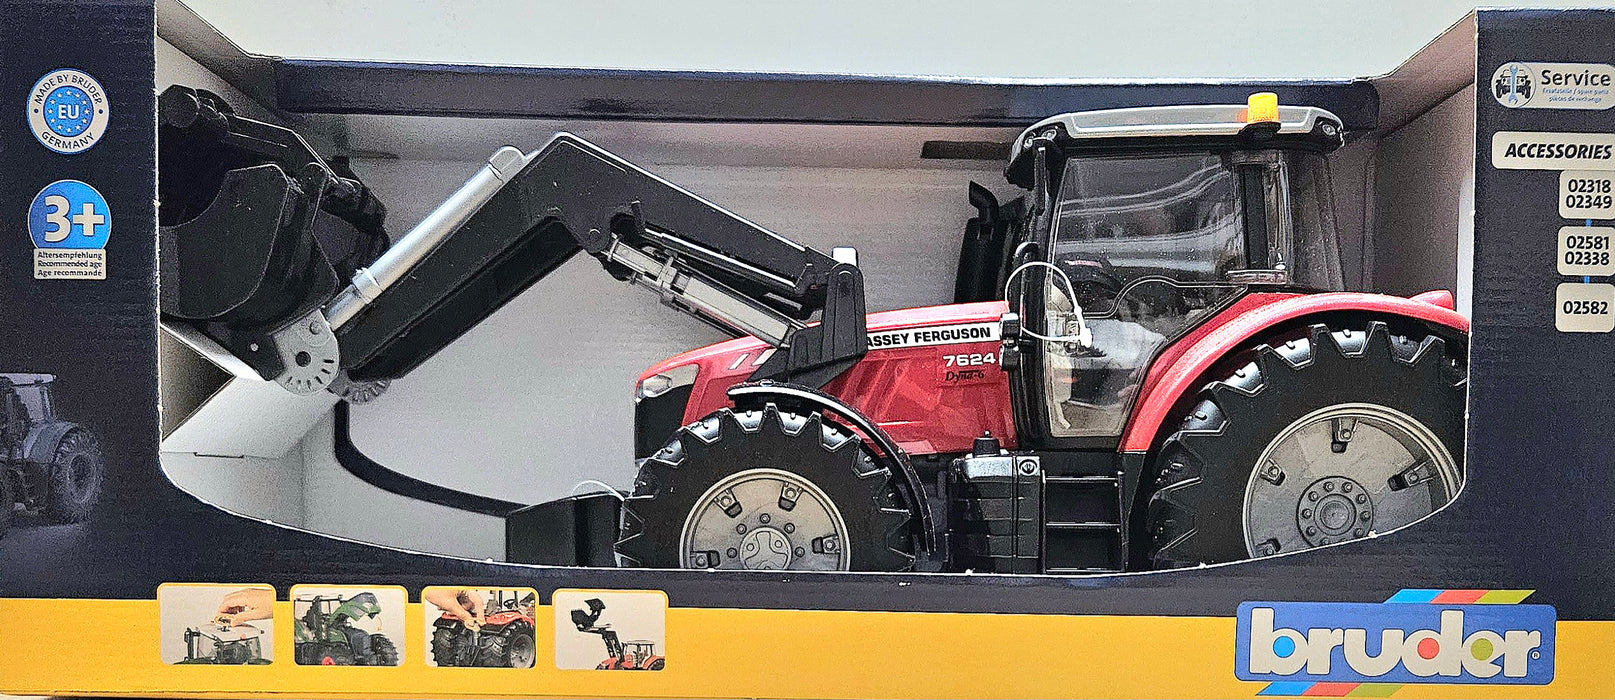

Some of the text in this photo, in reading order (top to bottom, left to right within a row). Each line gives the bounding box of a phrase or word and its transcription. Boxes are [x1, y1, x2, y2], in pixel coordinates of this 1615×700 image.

[1541, 69, 1612, 86] Service
[34, 74, 103, 104] MADE BY BRUDER
[58, 104, 80, 120] EU
[41, 131, 95, 149] GERMANY
[1504, 143, 1613, 160] ACCESSORIES
[1568, 179, 1612, 193] 02318
[1565, 195, 1613, 209] 02349
[45, 195, 105, 242] 3+
[1566, 235, 1610, 250] 02581
[37, 251, 103, 260] Altersempfehlung
[1564, 251, 1610, 266] 02338
[37, 260, 88, 268] Recommended
[37, 269, 52, 278] Age
[1563, 301, 1608, 315] 02582
[866, 326, 991, 347] ASSEY FERGUSON
[942, 352, 996, 367] 7624
